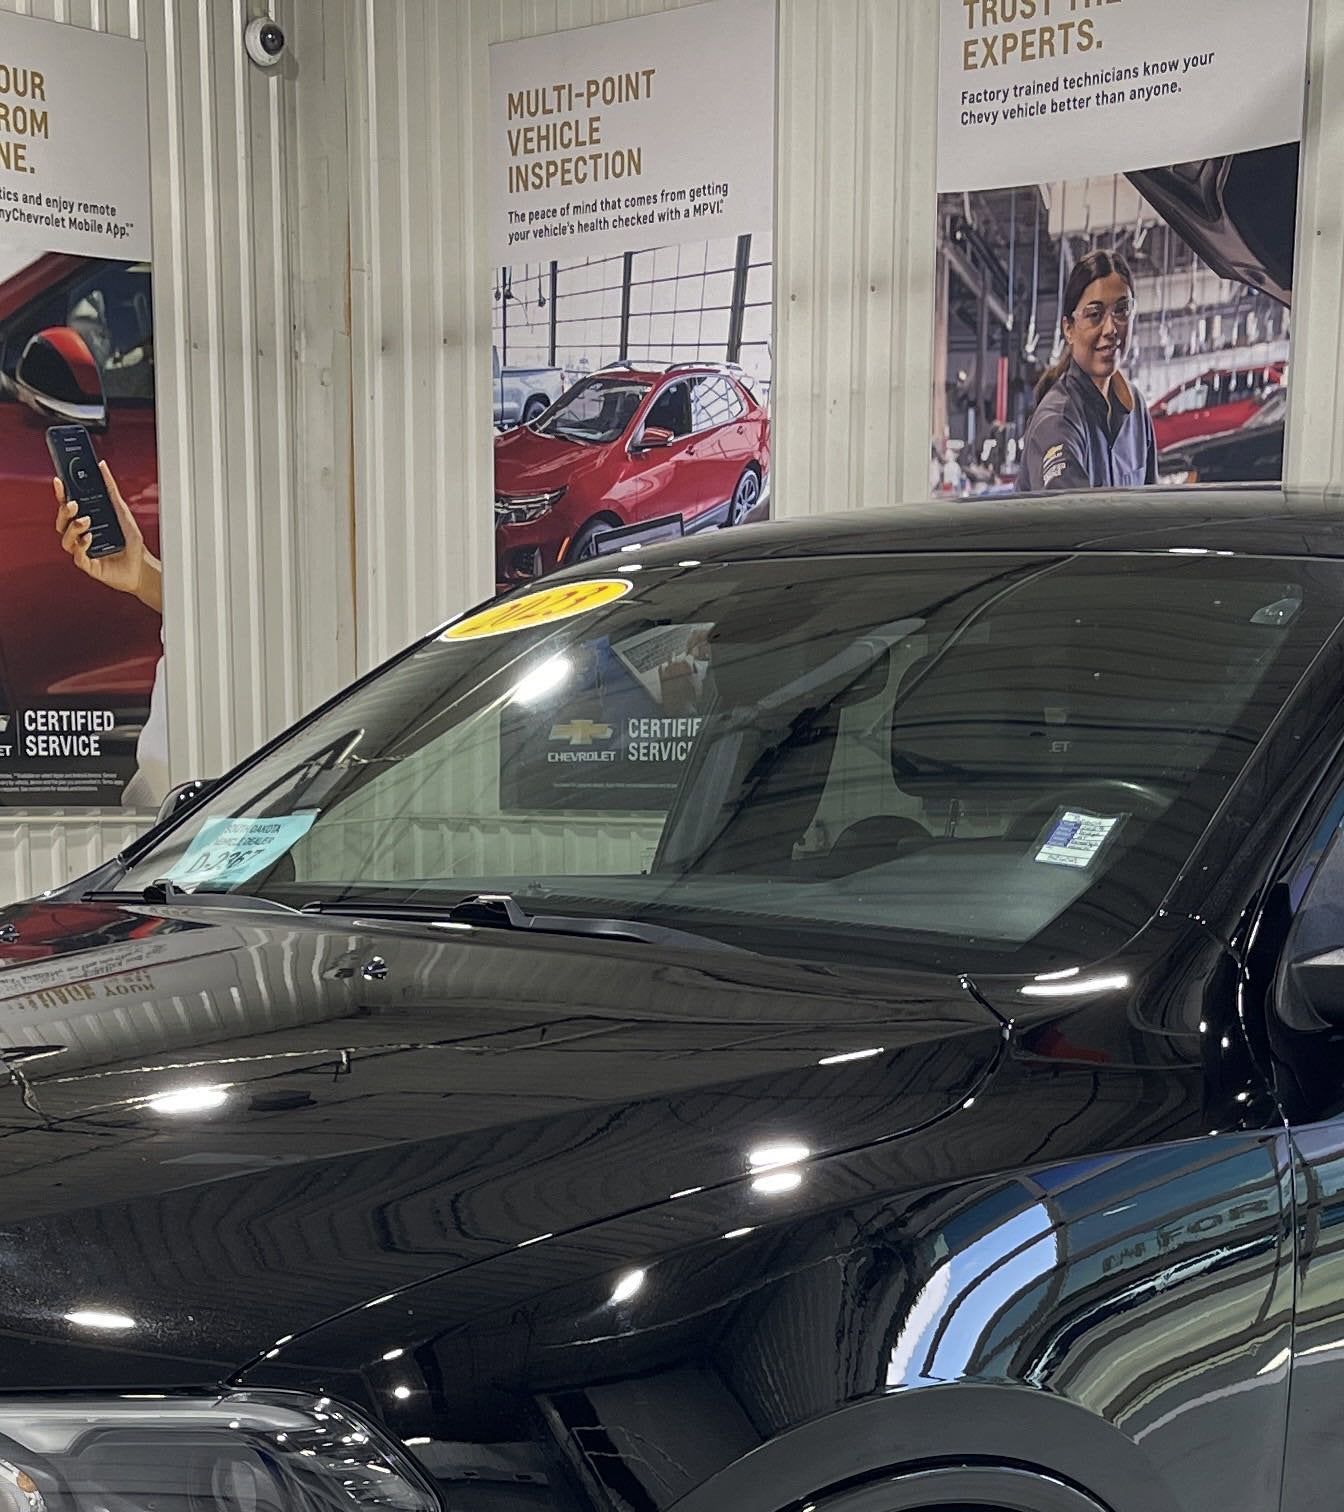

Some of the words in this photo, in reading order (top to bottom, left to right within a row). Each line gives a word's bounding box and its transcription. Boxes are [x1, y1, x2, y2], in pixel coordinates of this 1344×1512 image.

[963, 18, 1103, 71] EXPERTS.
[508, 69, 656, 120] MULTI-POINT
[961, 86, 1009, 105] Factory
[1013, 77, 1059, 97] trained
[1063, 66, 1139, 90] technicians
[1143, 59, 1179, 77] know
[1182, 52, 1215, 74] your
[960, 108, 999, 126] Chevy
[1002, 101, 1047, 121] vehicle
[1051, 94, 1092, 114] better
[1095, 89, 1125, 107] than
[1129, 81, 1182, 103] anyone.
[507, 116, 601, 157] VEHICLE
[508, 147, 642, 194] INSPECTION
[22, 193, 42, 206] and
[46, 196, 74, 214] enjoy
[77, 201, 116, 217] remote
[508, 211, 526, 225] The
[528, 208, 557, 225] peace
[560, 203, 570, 218] of
[572, 199, 598, 216] mind
[600, 195, 622, 213] that
[624, 194, 658, 209] comes
[660, 190, 686, 204] from
[689, 182, 729, 202] getting
[68, 217, 103, 234] Mobile
[508, 231, 530, 245] your
[533, 223, 575, 239] vehicle's
[577, 216, 610, 234] health
[612, 210, 655, 228] checked
[657, 206, 681, 223] with
[684, 209, 690, 218] a
[24, 709, 115, 732] CERTIFIED
[25, 735, 101, 757] SERVICE
[547, 751, 616, 762] CHEVROLET
[628, 742, 693, 761] SERVIC
